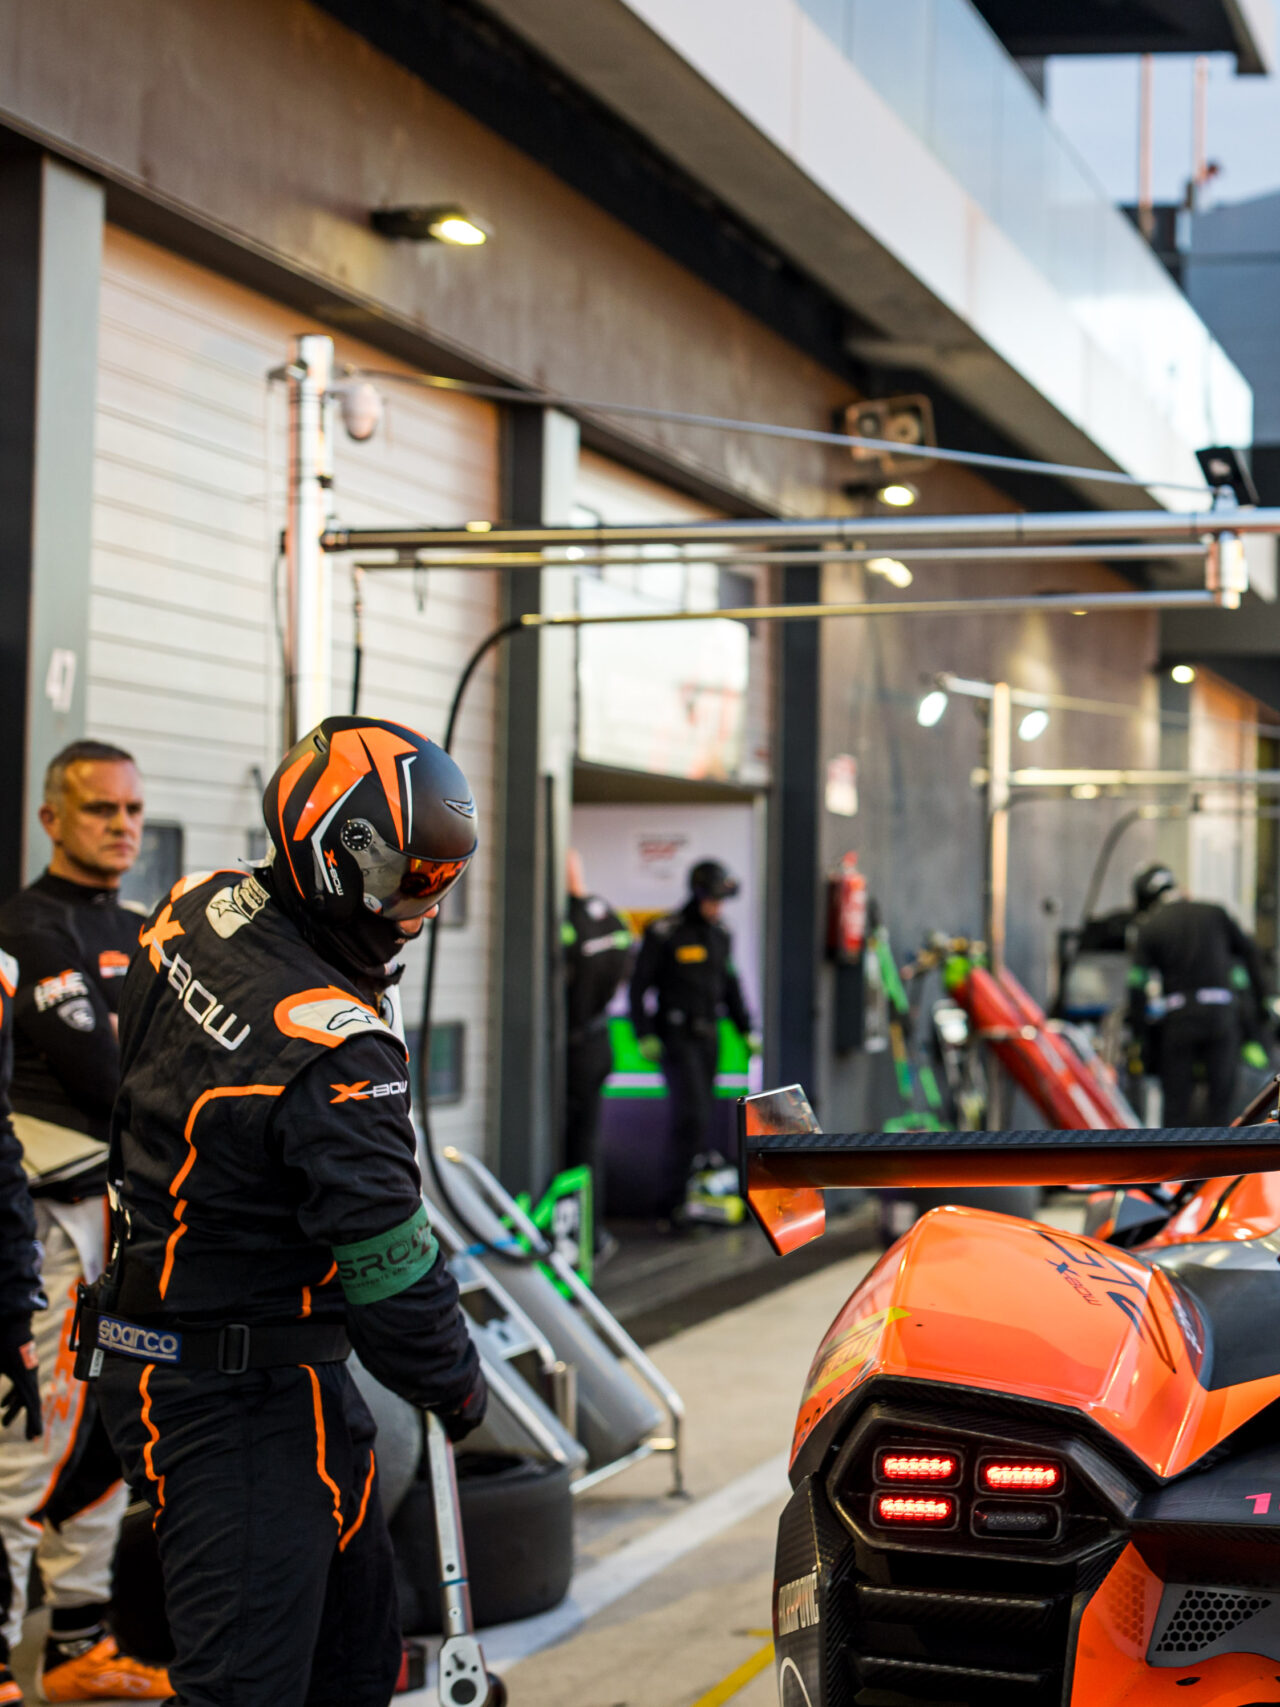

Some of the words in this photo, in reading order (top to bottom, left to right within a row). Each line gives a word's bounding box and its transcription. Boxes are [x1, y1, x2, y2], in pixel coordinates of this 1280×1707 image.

[323, 849, 344, 896] X-BOW
[329, 1080, 408, 1104] X-BOW
[98, 1320, 178, 1354] sparco
